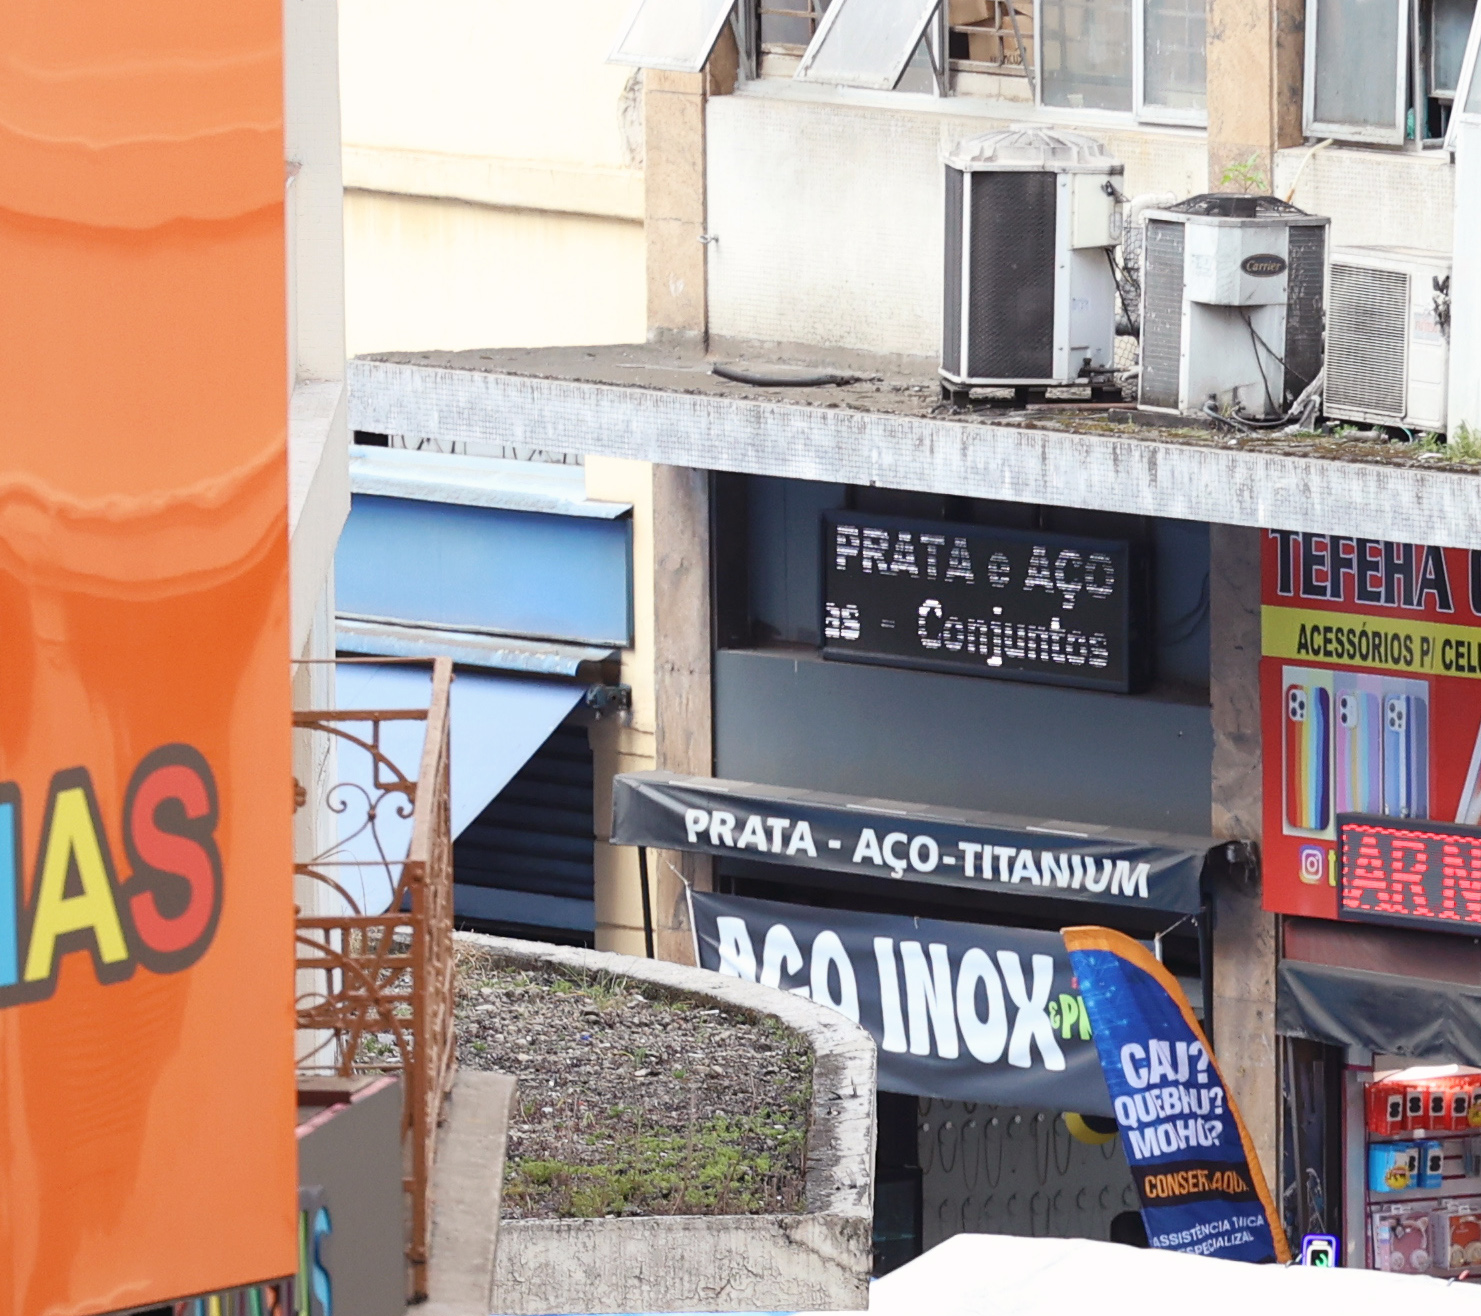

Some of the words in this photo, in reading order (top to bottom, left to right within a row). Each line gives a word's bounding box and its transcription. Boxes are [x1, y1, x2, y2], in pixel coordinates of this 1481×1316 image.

[1246, 261, 1281, 272] Carrier
[836, 525, 974, 584] PRATA
[987, 552, 1010, 588] e
[1023, 546, 1114, 609] AÇO
[918, 599, 1109, 668] Conjuntos
[1296, 621, 1413, 666] ACESSÓRIOS
[1420, 636, 1435, 669] P/
[685, 808, 818, 857] PRATA
[873, 935, 1067, 1072] INOX
